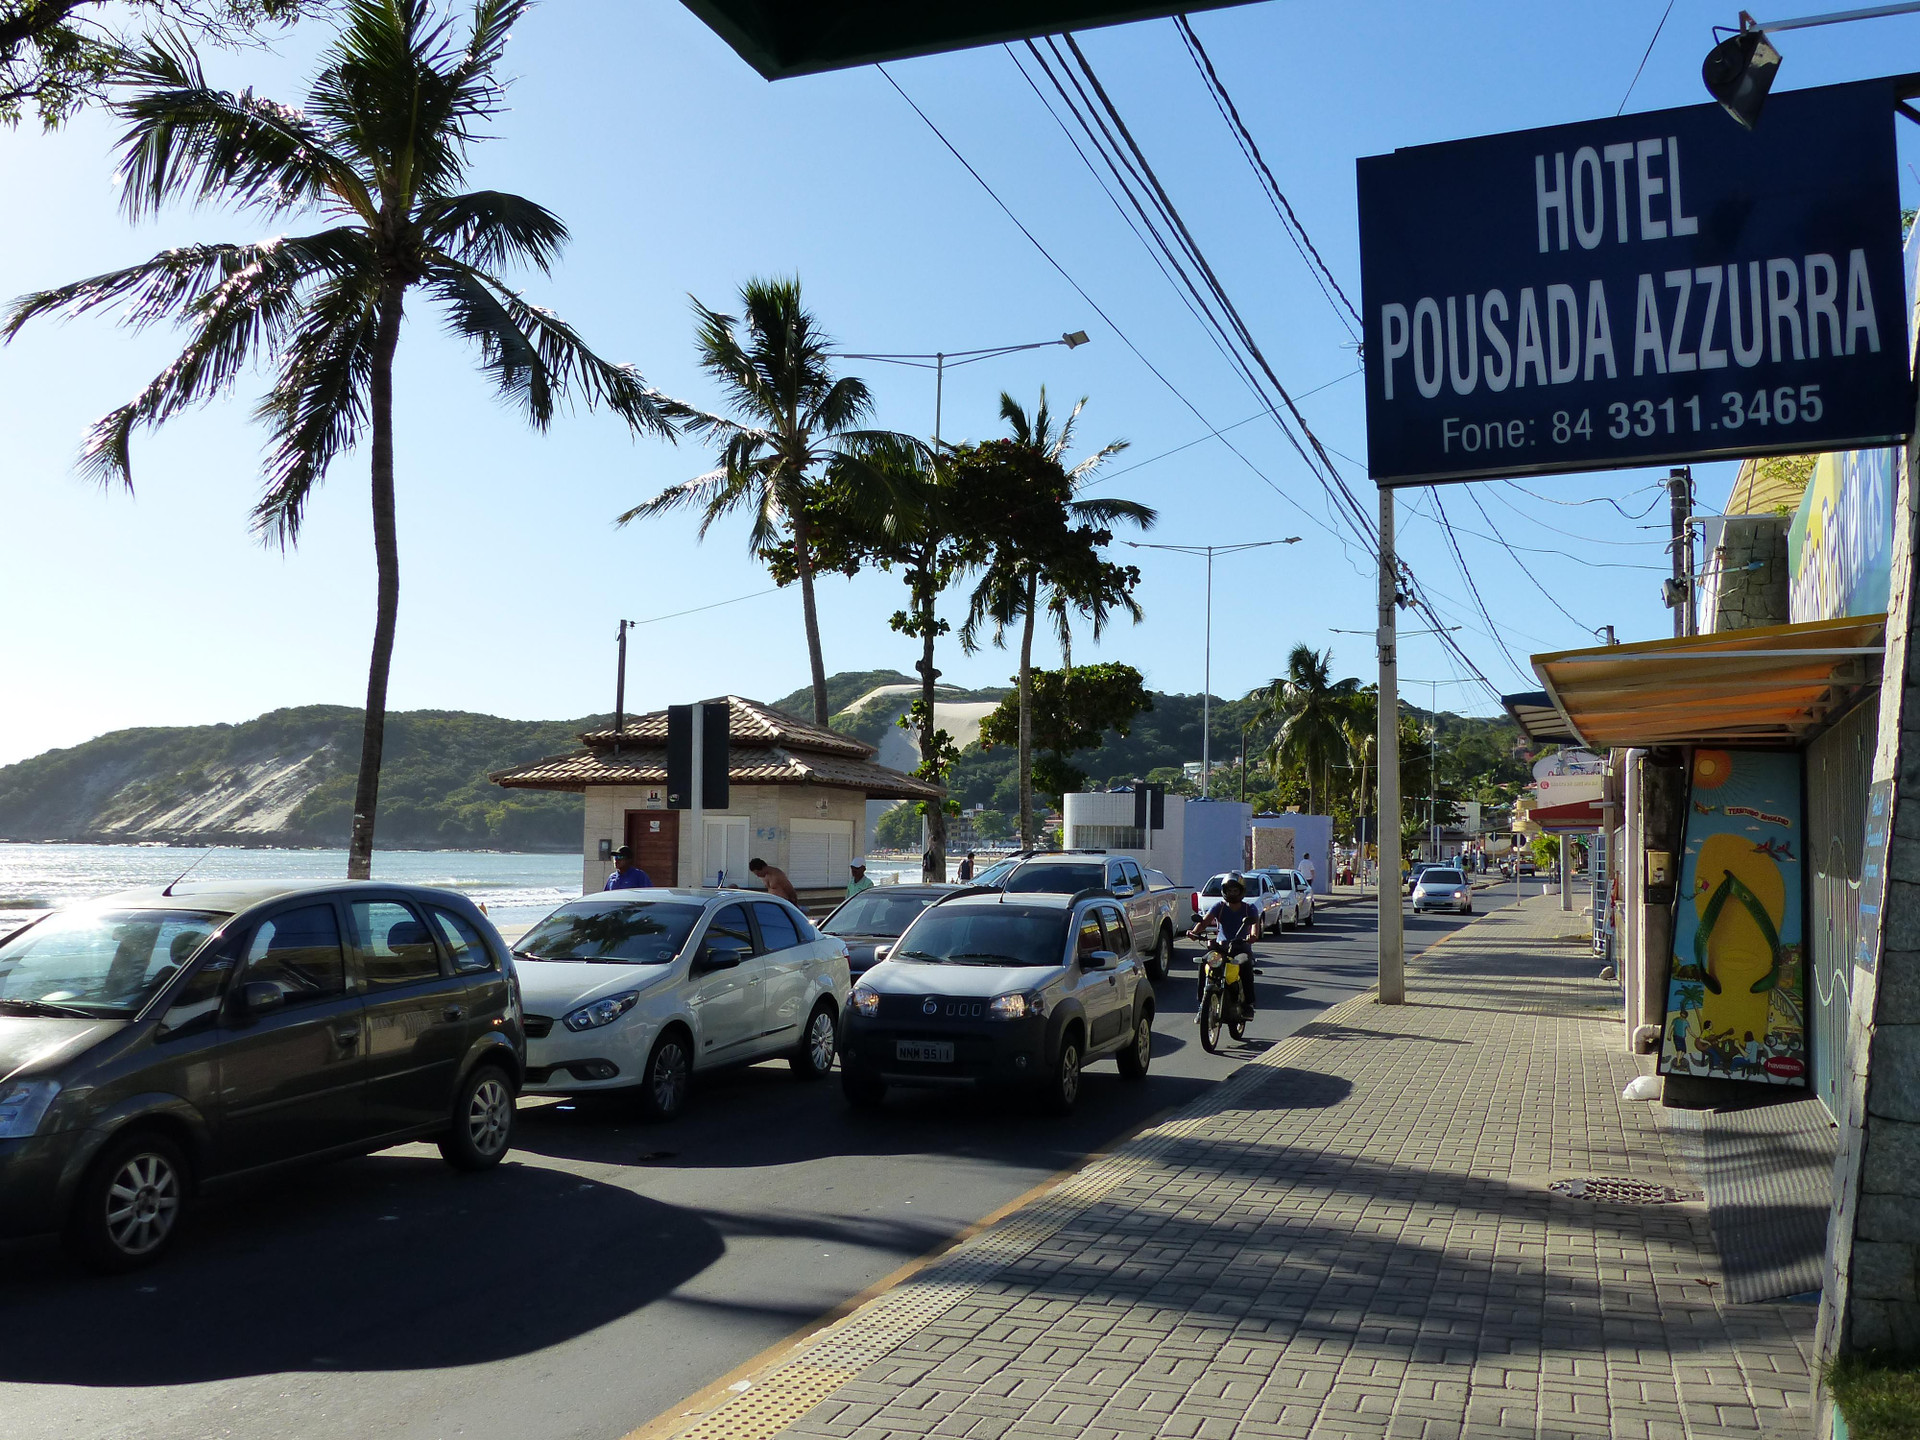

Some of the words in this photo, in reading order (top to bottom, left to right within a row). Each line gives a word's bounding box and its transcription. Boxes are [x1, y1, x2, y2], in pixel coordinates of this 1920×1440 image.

[1535, 136, 1698, 253] HOTEL
[1381, 279, 1617, 400] POUSADA
[1633, 248, 1881, 376] AZZURRA
[1443, 414, 1536, 453] Fone:
[1552, 409, 1593, 444] 84
[1608, 384, 1824, 439] 3311.3465
